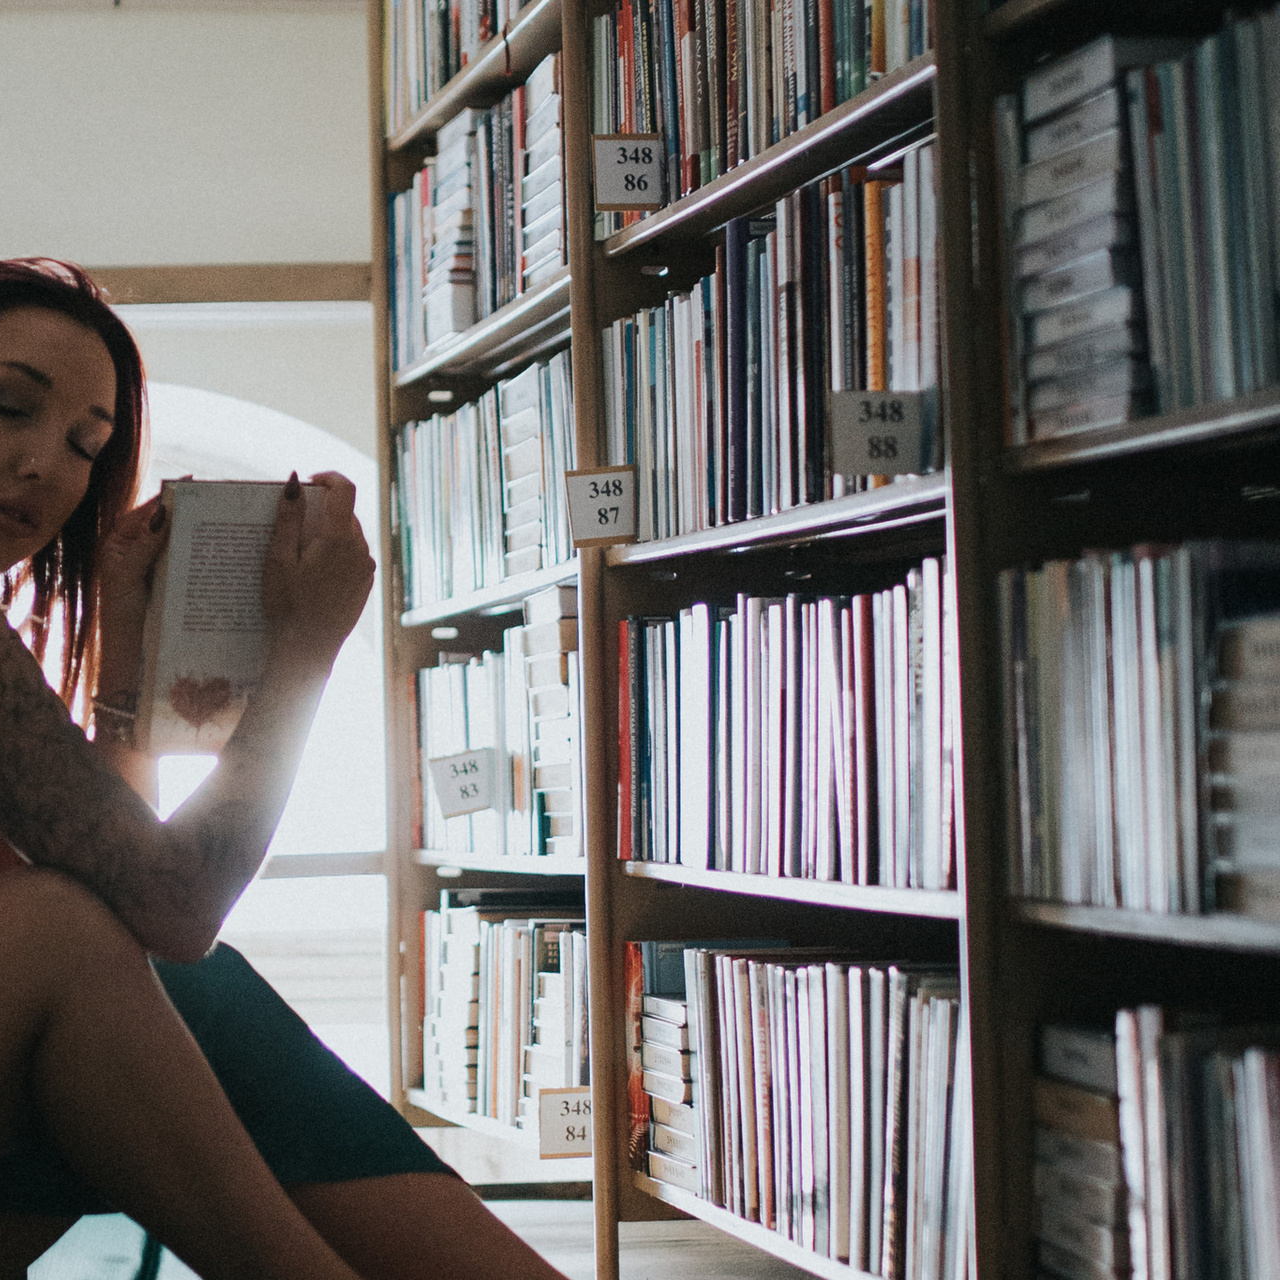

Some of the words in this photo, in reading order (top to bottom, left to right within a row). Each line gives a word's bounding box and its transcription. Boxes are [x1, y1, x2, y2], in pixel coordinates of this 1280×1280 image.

[616, 146, 654, 165] 348
[623, 173, 649, 192] 86
[858, 401, 905, 425] 348
[867, 436, 899, 460] 88
[588, 480, 623, 499] 348
[596, 506, 621, 526] 87
[449, 758, 479, 780] 348
[459, 782, 479, 800] 83
[560, 1098, 592, 1118] 348
[565, 1124, 587, 1142] 84
